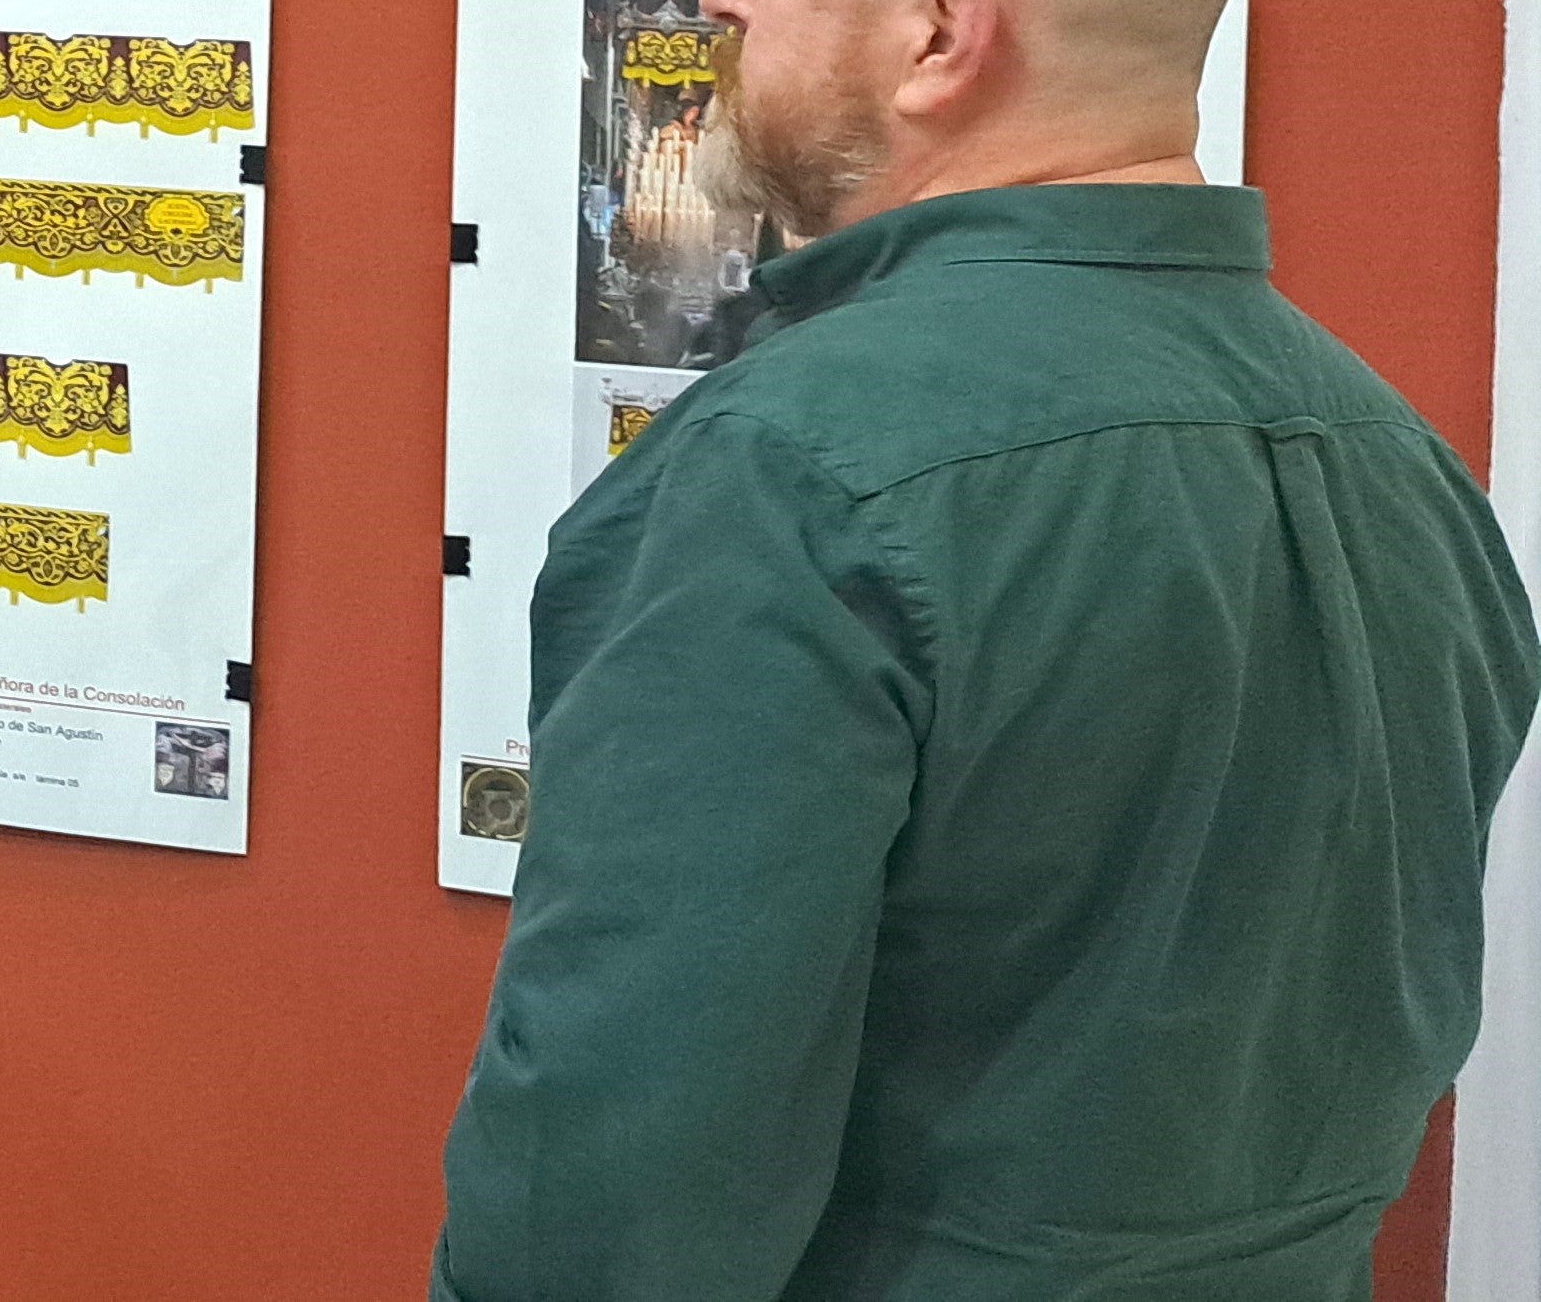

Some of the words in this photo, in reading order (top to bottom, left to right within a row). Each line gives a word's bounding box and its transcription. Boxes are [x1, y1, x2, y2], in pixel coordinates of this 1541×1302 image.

[38, 681, 59, 697] de
[63, 683, 79, 699] la
[83, 686, 185, 711] Consolación
[7, 720, 24, 732] de
[27, 721, 52, 735] San
[55, 724, 103, 741] Agustín
